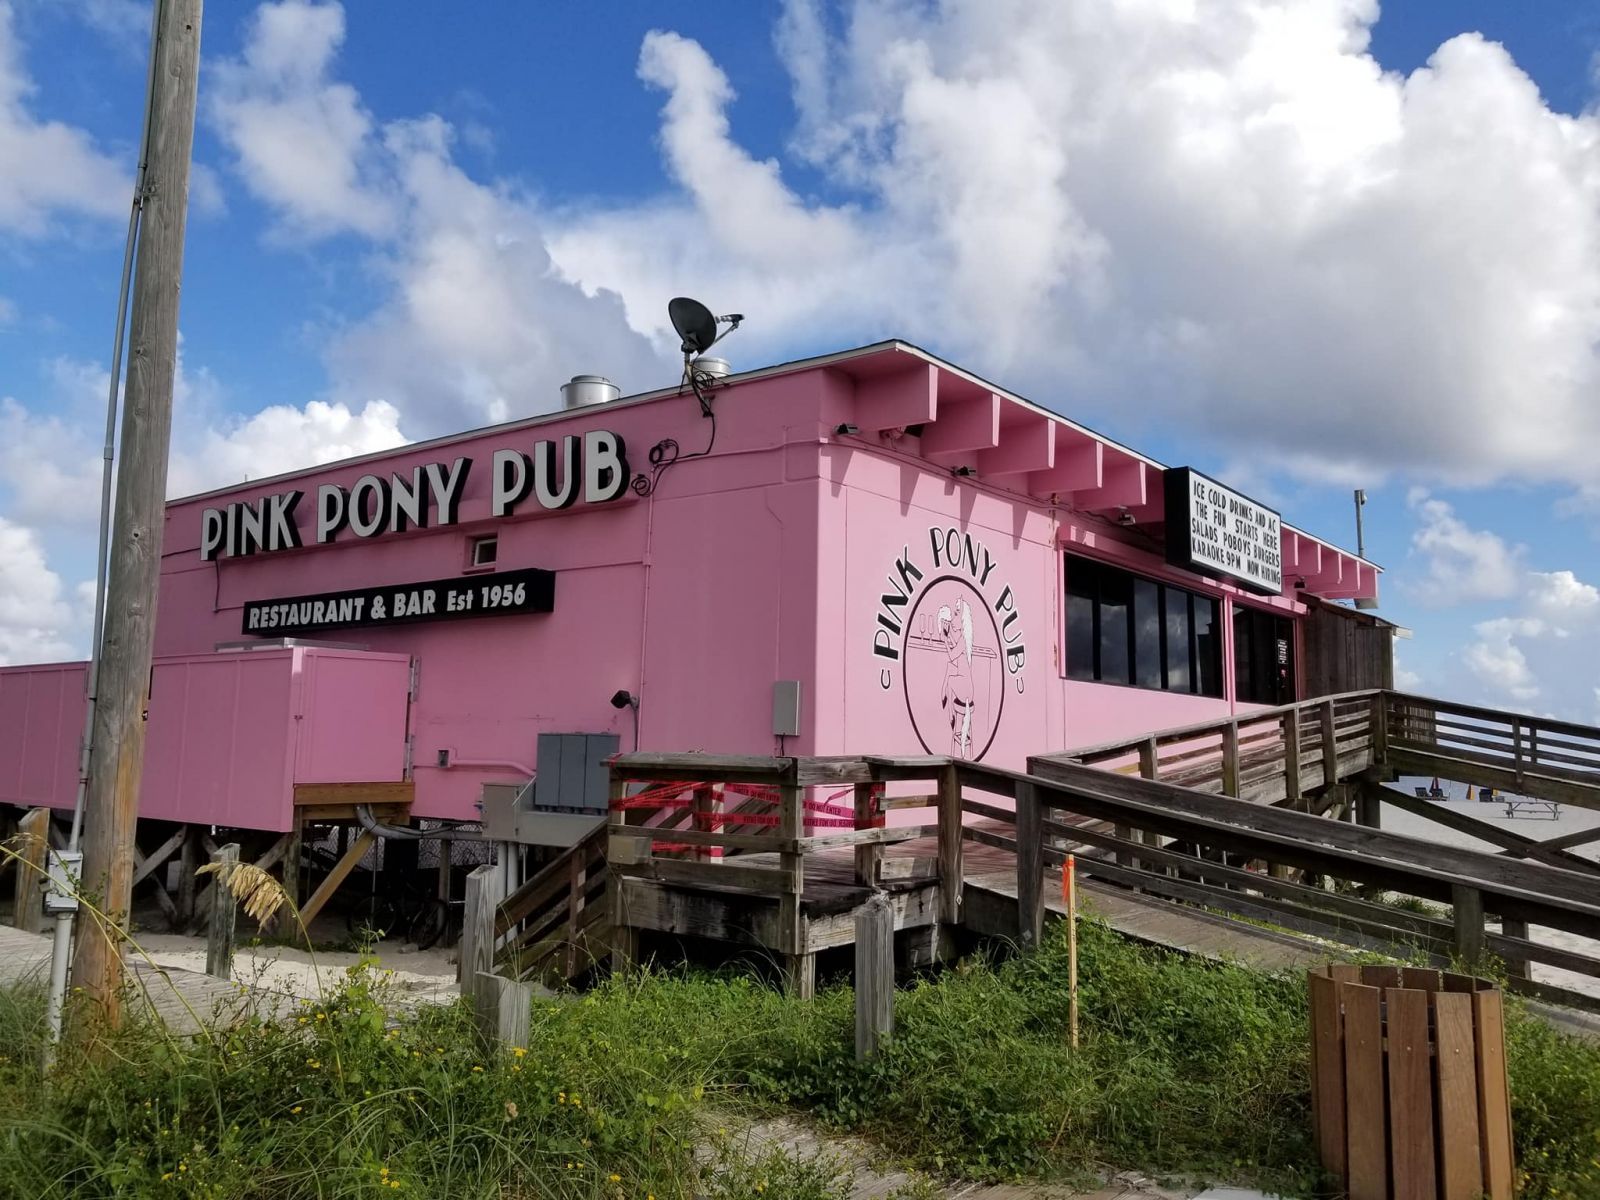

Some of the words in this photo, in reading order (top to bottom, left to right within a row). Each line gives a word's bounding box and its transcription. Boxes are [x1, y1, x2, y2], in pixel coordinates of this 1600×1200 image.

[201, 490, 304, 561] PINK
[317, 457, 473, 543] PONY
[492, 430, 630, 517] PUB
[1193, 480, 1205, 500] ICE
[1208, 489, 1226, 509] COLD
[1230, 499, 1253, 522] DRINKS
[1255, 510, 1266, 527] AND
[1268, 518, 1276, 533] AC
[1192, 518, 1218, 543] SALADS
[1223, 532, 1251, 556] POBOYS
[1253, 545, 1280, 568] BURGERS
[1195, 501, 1208, 520] THE
[1213, 509, 1226, 528] FUN
[1235, 519, 1258, 541] STARTS
[1263, 533, 1277, 550] HERE
[1192, 537, 1224, 564] KARAOKE
[1226, 554, 1241, 569] 9PM
[1247, 559, 1259, 577] NOW
[249, 597, 365, 629] RESTAURANT
[370, 595, 386, 620] &
[393, 589, 436, 617] BAR
[447, 589, 473, 612] Est
[480, 583, 526, 608] 1956
[873, 546, 924, 660] PINK
[929, 527, 997, 587] PONY
[994, 585, 1026, 675] PUB
[808, 802, 815, 810] DO
[816, 803, 826, 812] NOT
[826, 806, 841, 816] ENTER
